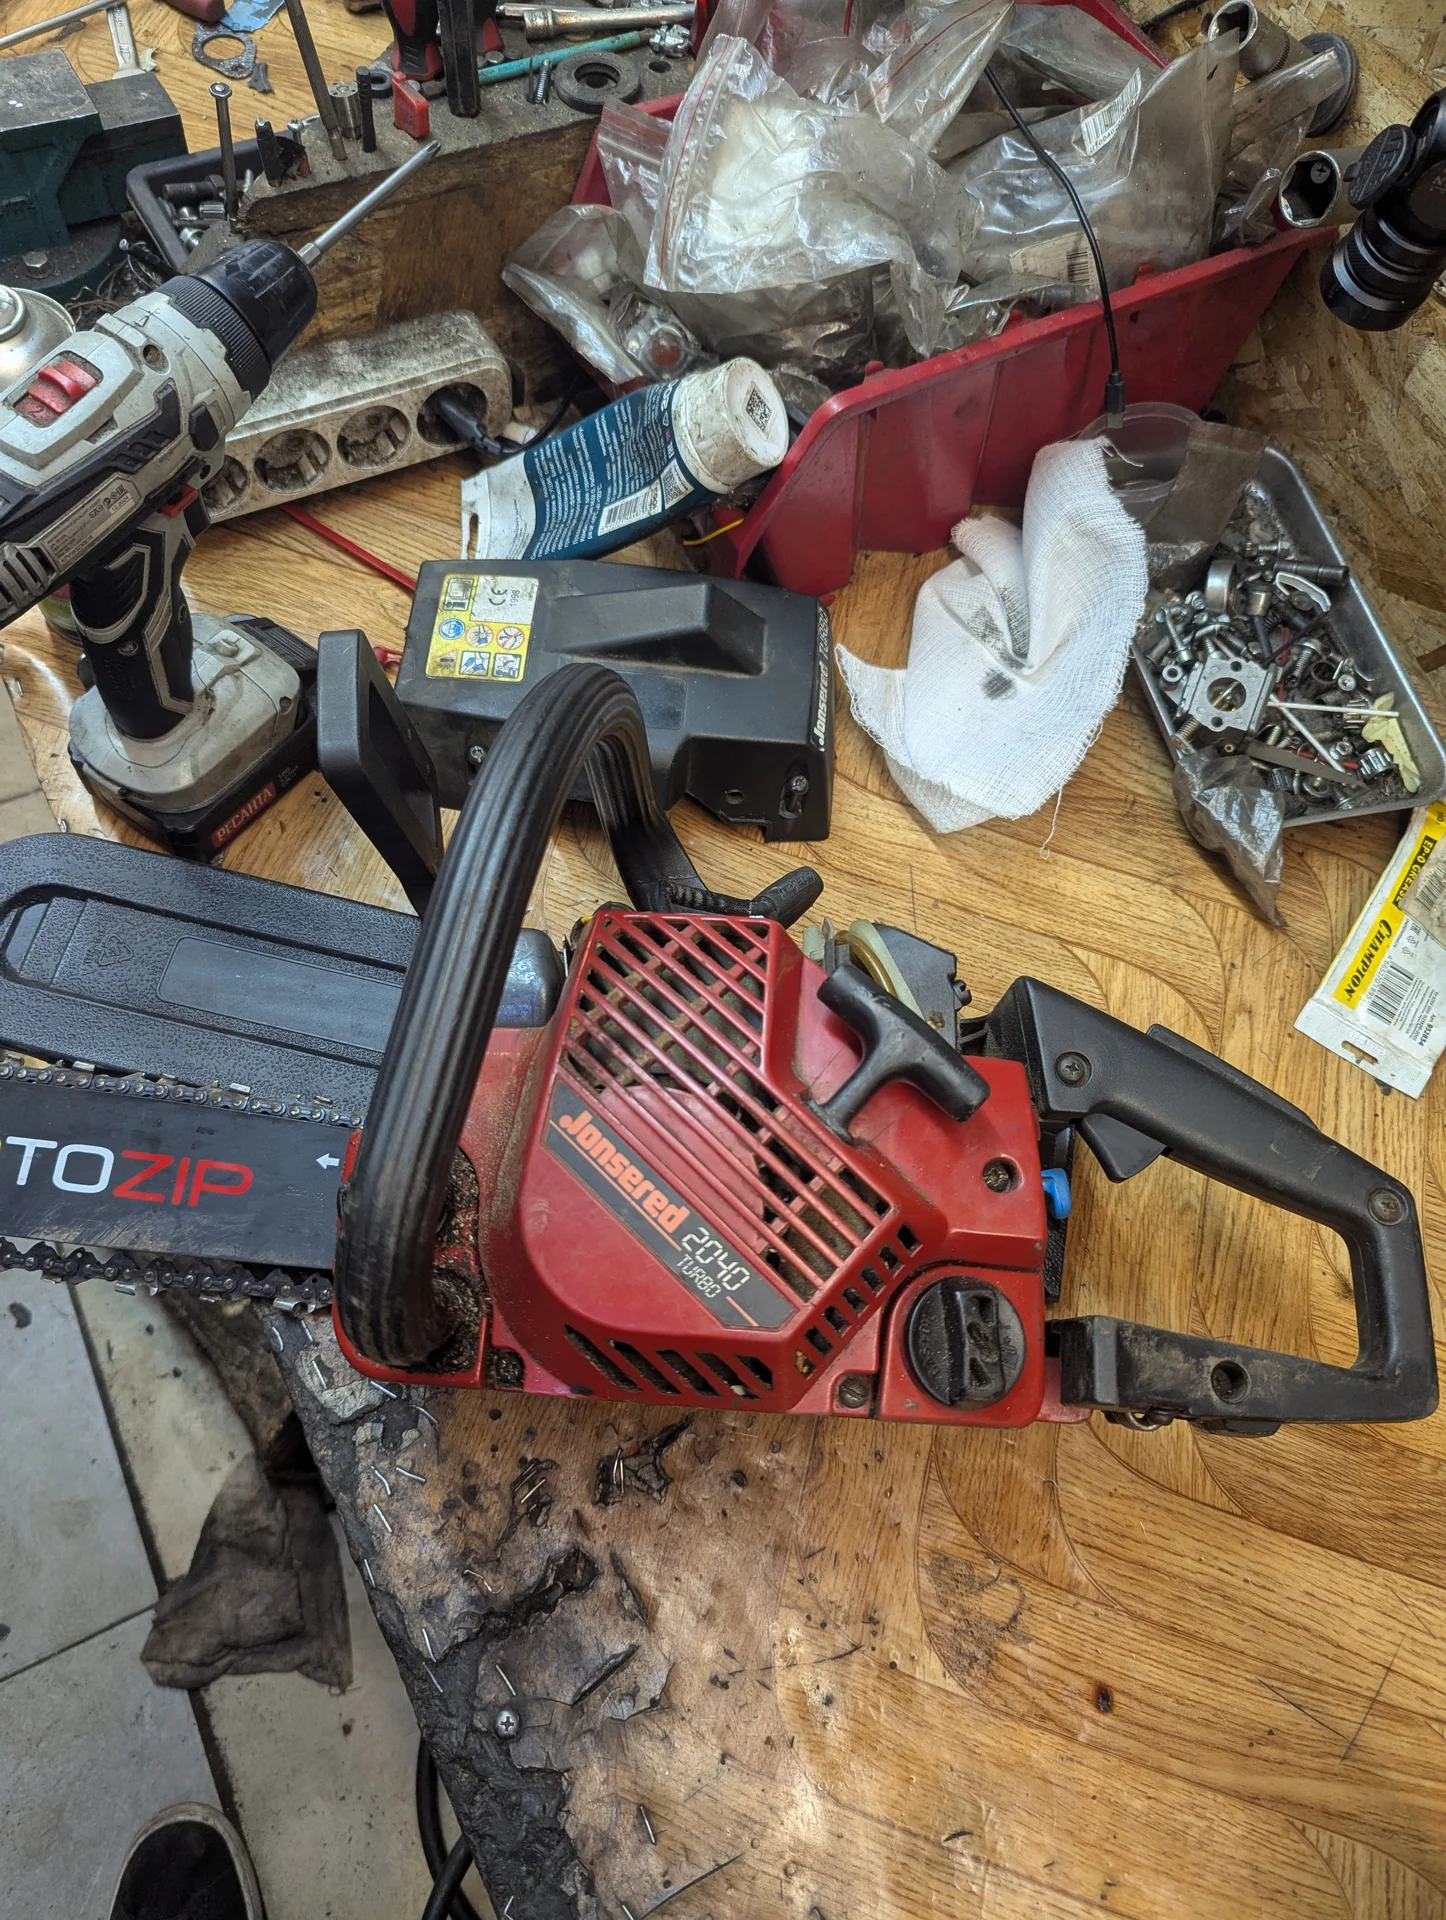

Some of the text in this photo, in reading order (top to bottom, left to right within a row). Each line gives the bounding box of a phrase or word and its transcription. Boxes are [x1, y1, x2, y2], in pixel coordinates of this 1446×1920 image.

[509, 589, 521, 607] 1998
[813, 605, 829, 745] Jonsered TURBO
[217, 788, 273, 842] РЕСАНТА
[1394, 863, 1421, 903] GREASE
[1344, 918, 1393, 1001] CHAMPION
[1417, 1022, 1433, 1047] 952834
[0, 1135, 254, 1207] TOZIP
[558, 1110, 751, 1292] Jonsered 2040
[676, 1253, 722, 1299] TURBO
